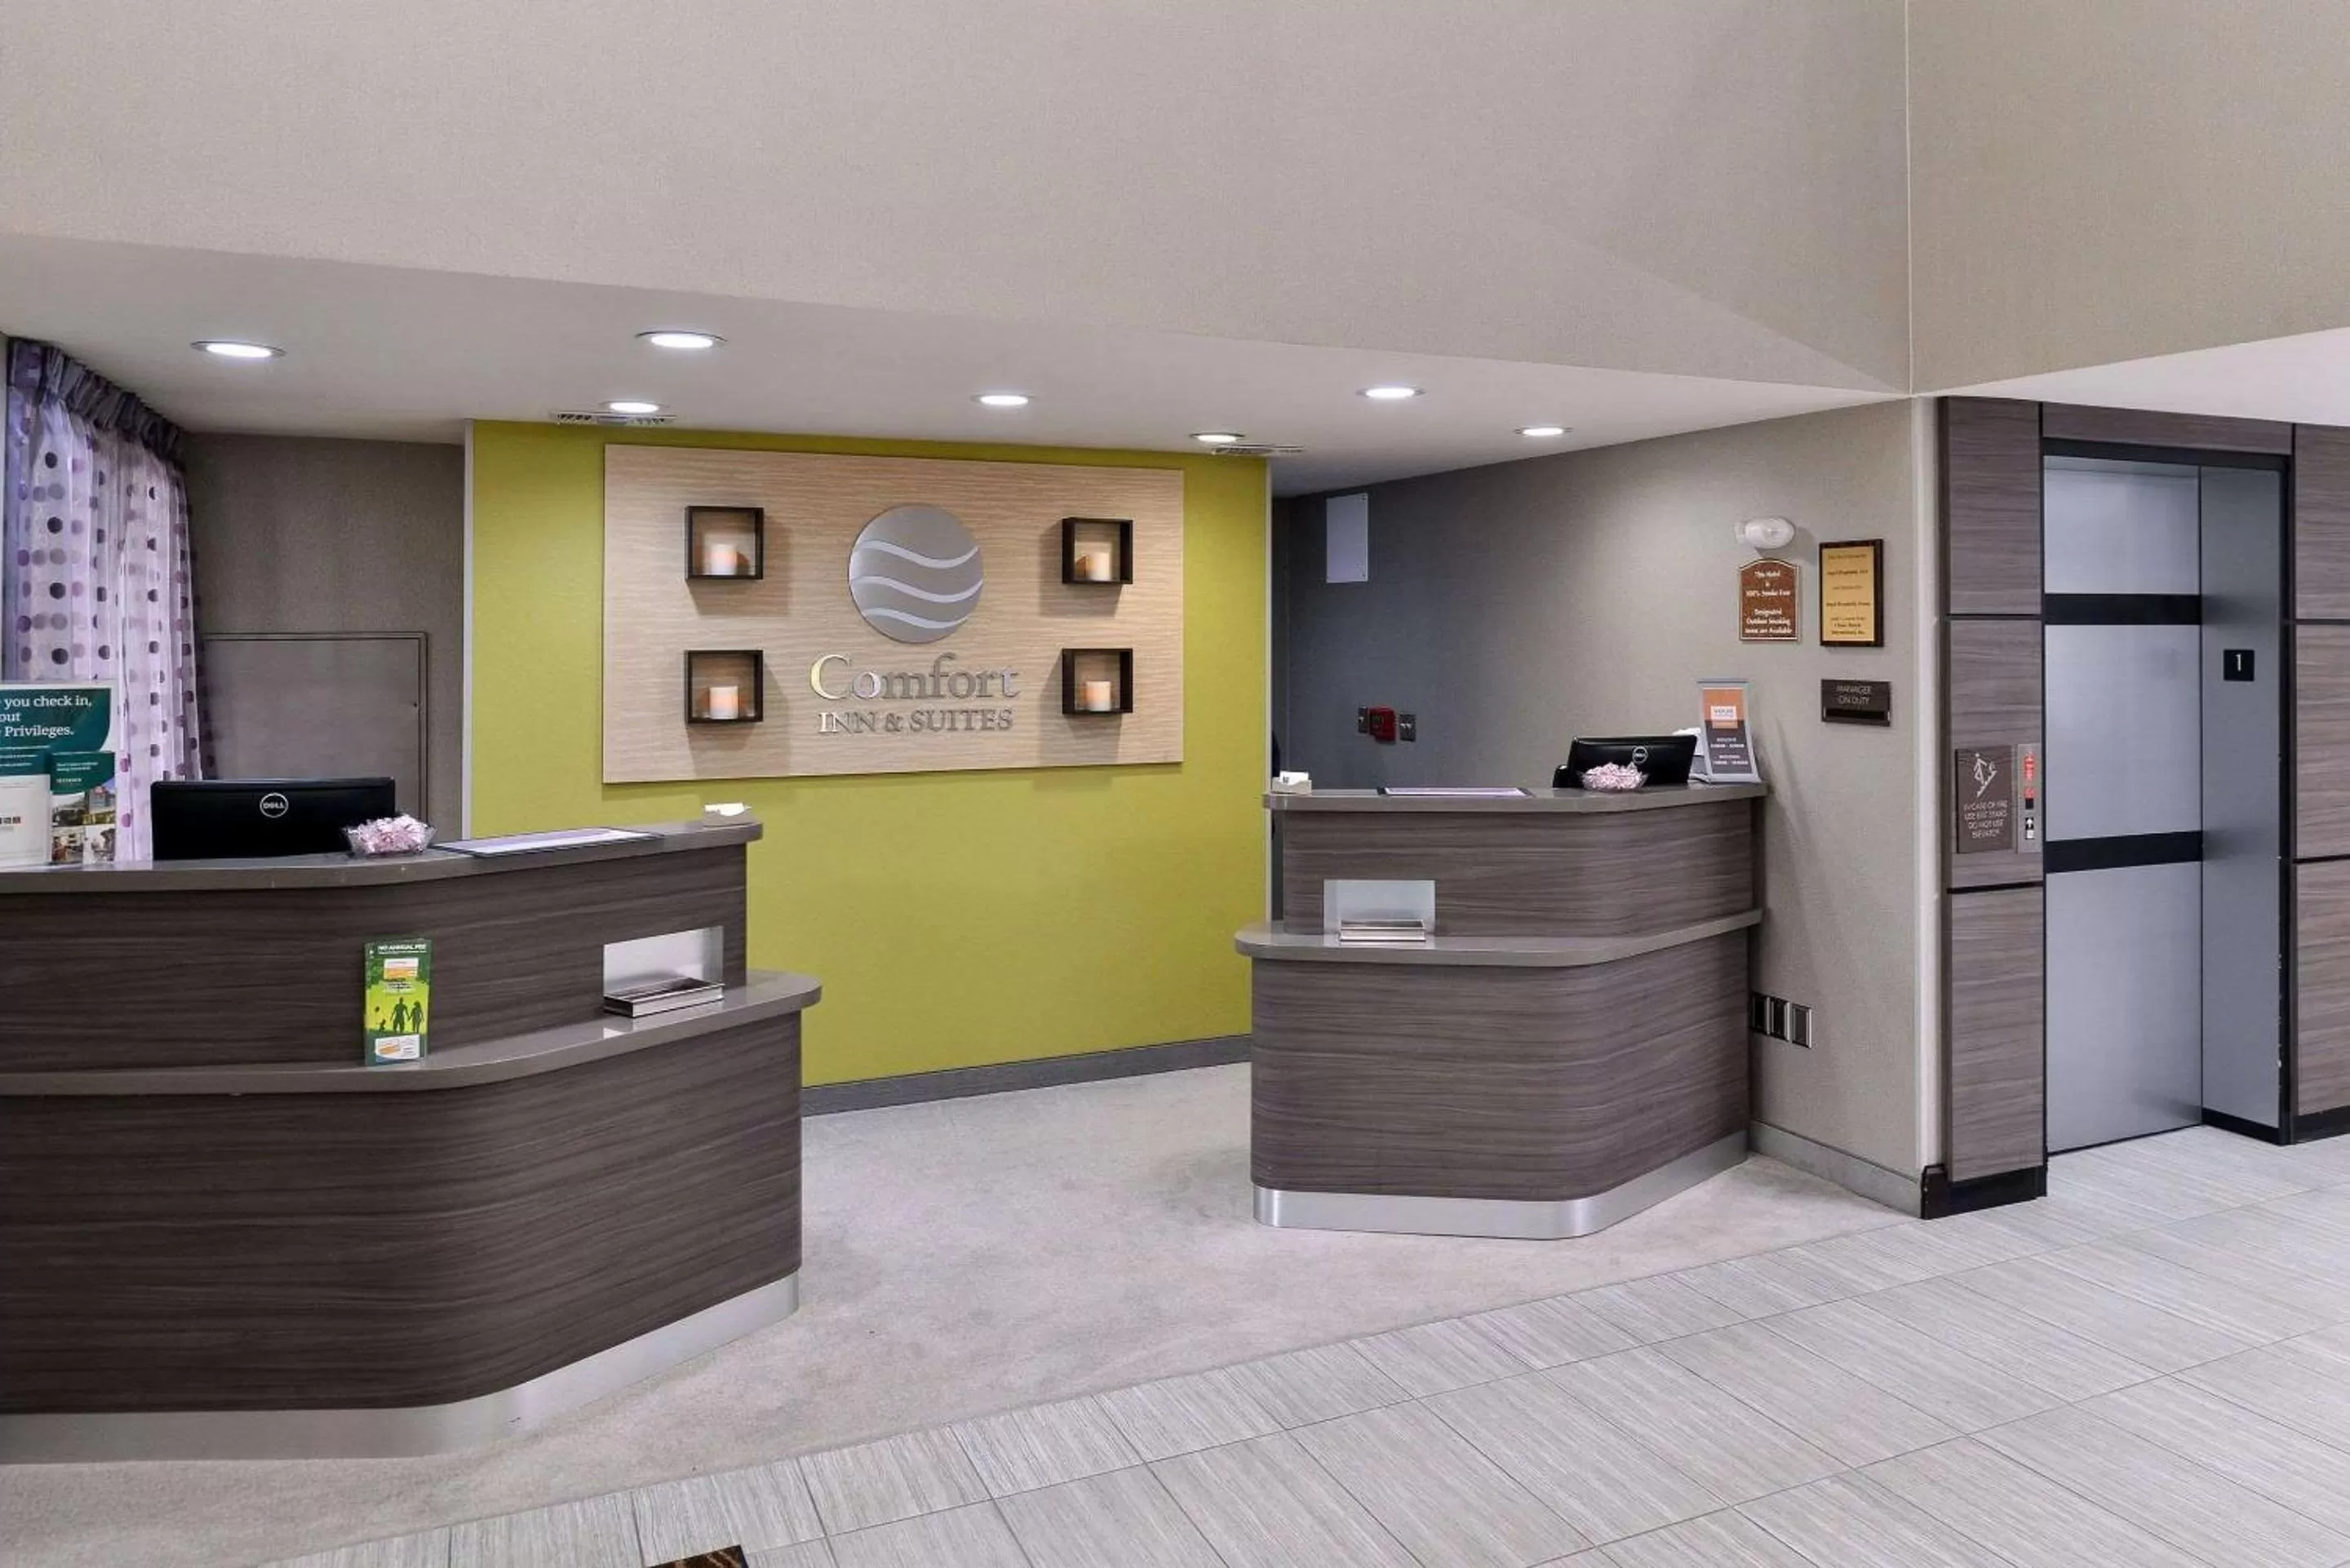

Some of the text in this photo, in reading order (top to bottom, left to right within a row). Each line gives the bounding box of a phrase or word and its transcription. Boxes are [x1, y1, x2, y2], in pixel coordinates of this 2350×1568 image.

[2235, 653, 2241, 671] 1
[809, 652, 1020, 701] Comfort
[1836, 685, 1873, 695] MANAGER
[3, 694, 92, 710] you check in,
[818, 708, 1013, 733] INN & SUITES
[4, 724, 74, 738] Privileges.
